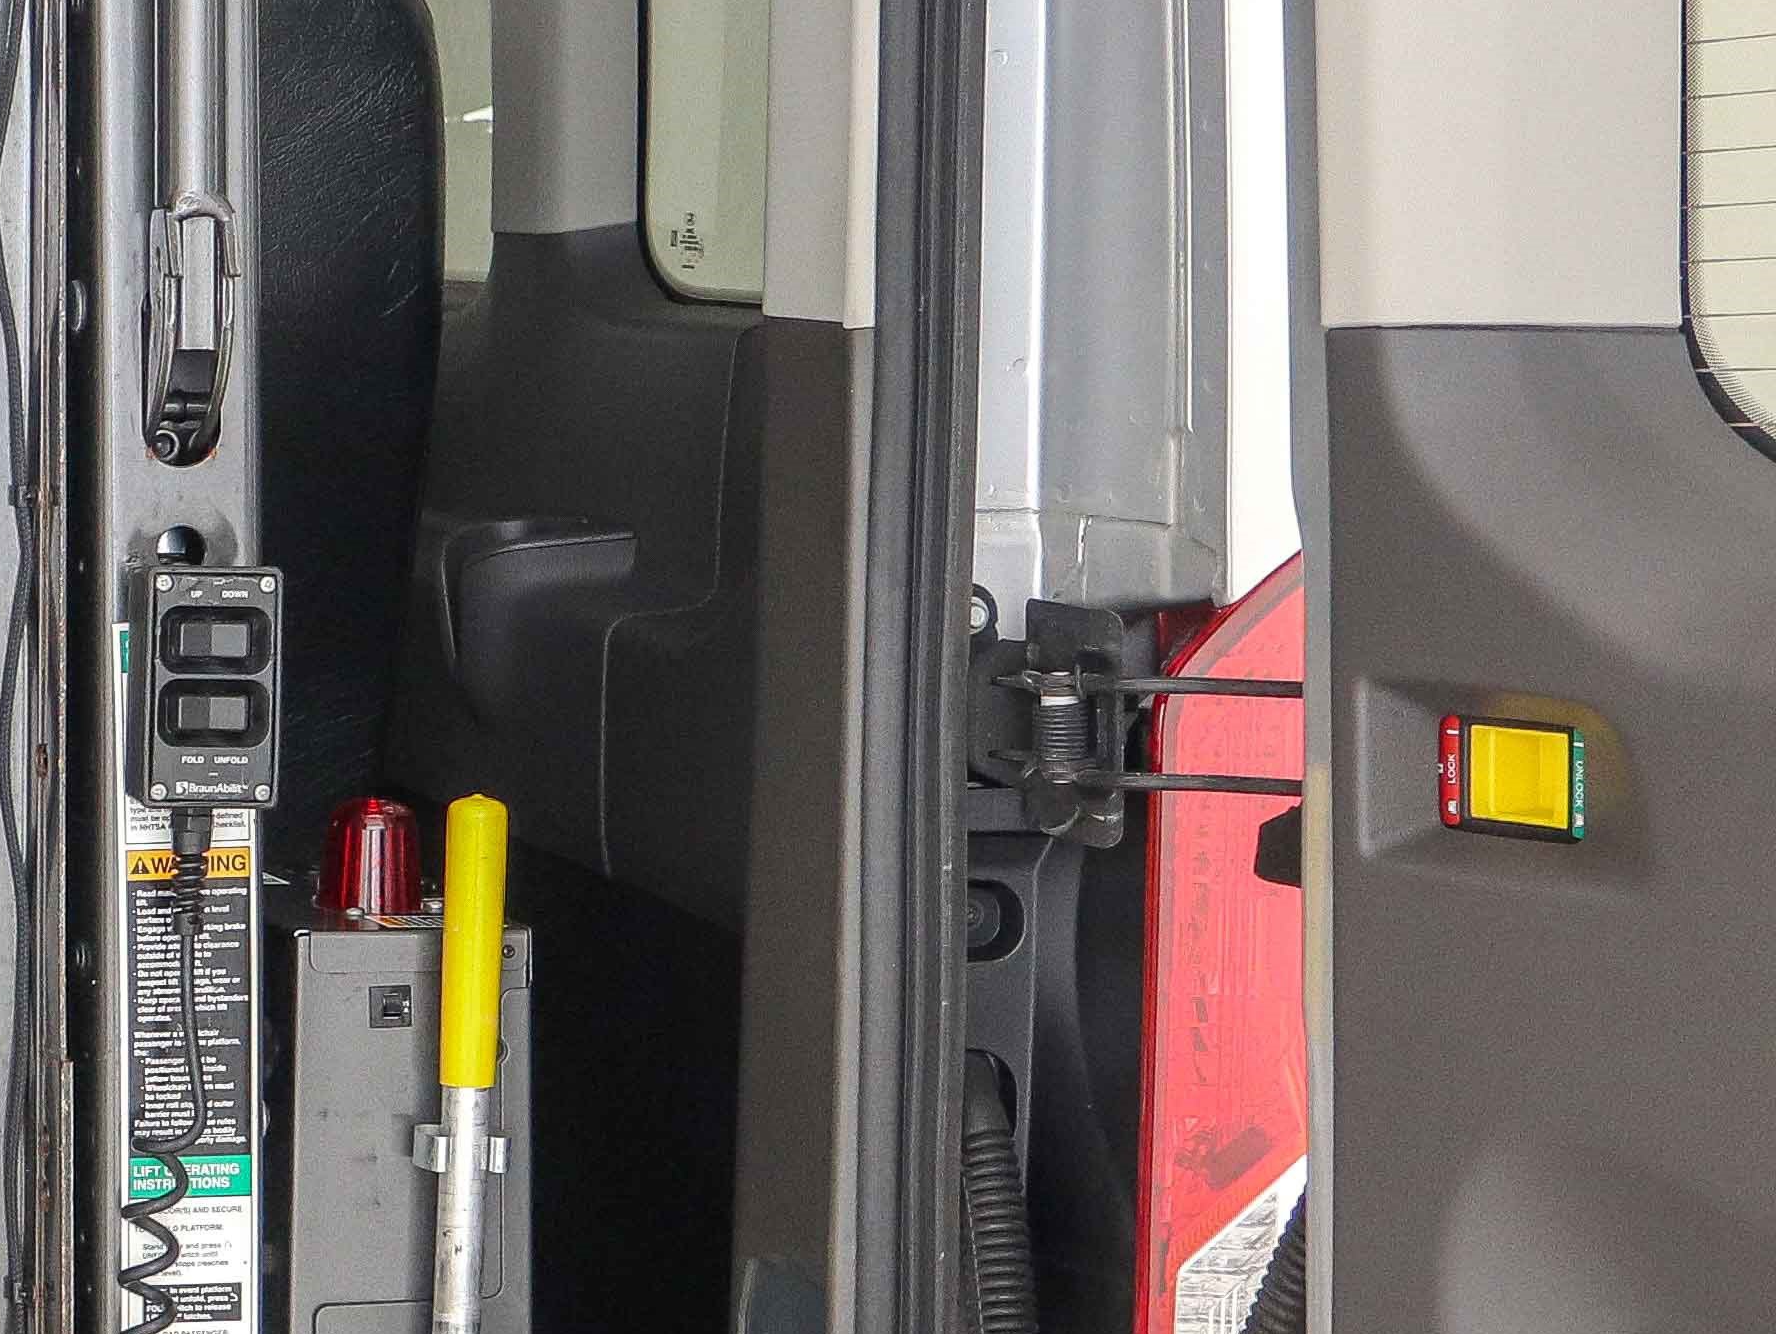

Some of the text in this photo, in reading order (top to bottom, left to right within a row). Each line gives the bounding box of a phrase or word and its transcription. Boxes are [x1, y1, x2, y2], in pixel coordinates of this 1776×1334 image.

[190, 590, 249, 599] UP DOWN
[181, 755, 249, 764] FOLD UNFOLD
[151, 854, 247, 874] WAING
[133, 1163, 240, 1177] LIFT OERATING
[133, 1176, 230, 1191] INSTRTIONS
